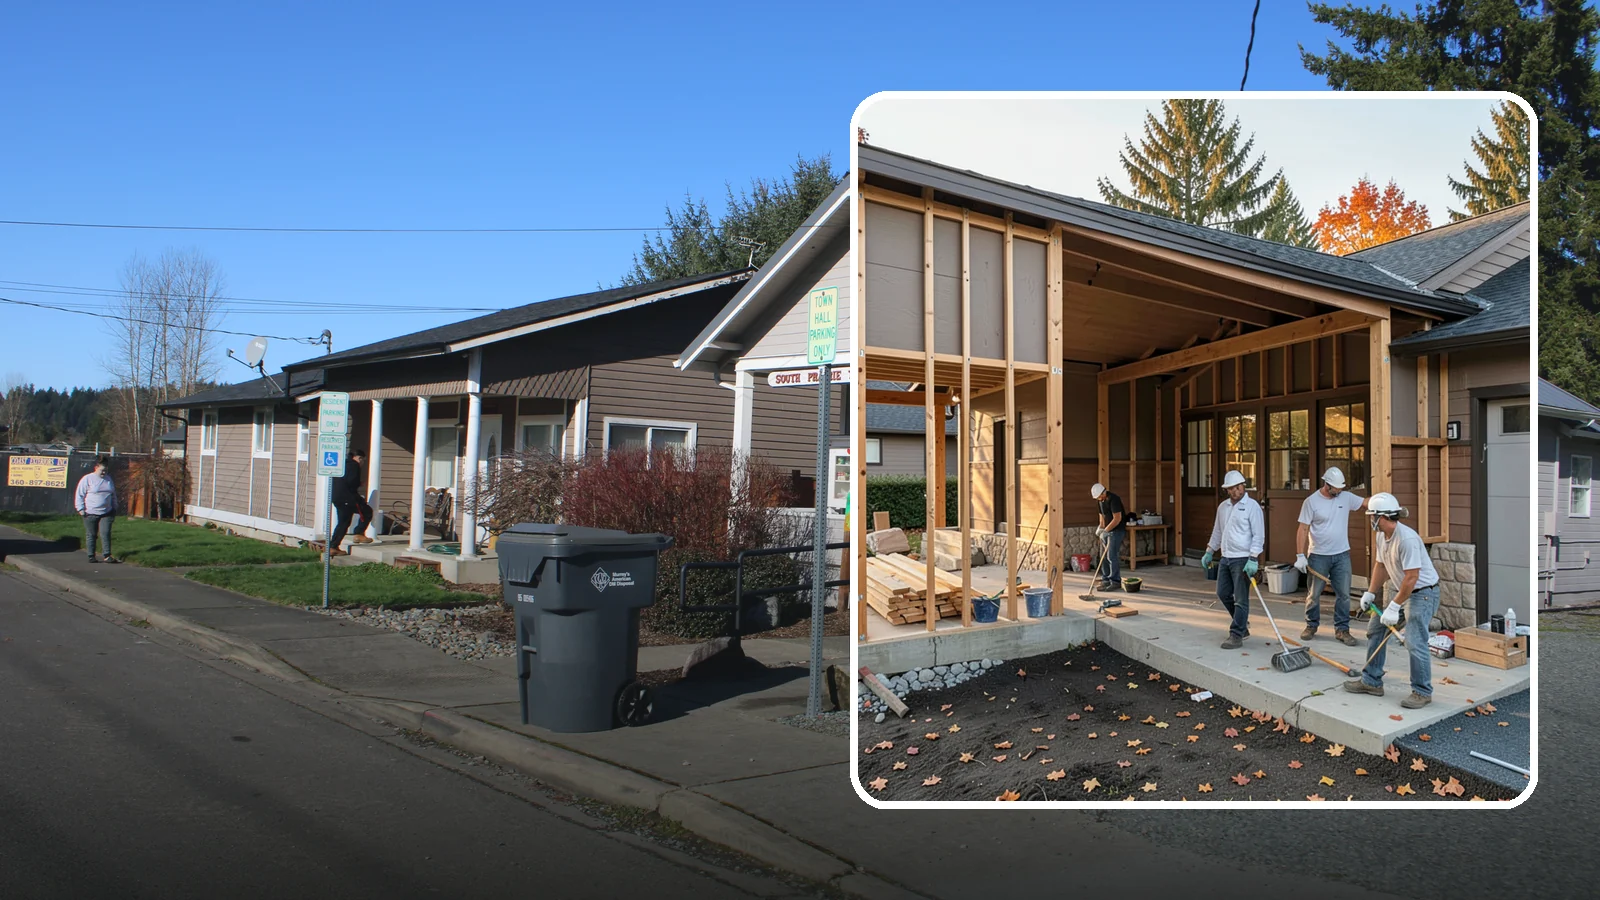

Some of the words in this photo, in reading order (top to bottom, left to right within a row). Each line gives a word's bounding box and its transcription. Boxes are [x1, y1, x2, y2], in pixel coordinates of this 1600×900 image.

[815, 294, 833, 307] TOWN
[815, 311, 831, 324] HALL
[809, 326, 836, 341] PARKING
[814, 344, 830, 356] ONLY
[775, 373, 801, 384] SOUTH
[808, 370, 842, 382] PRRIE
